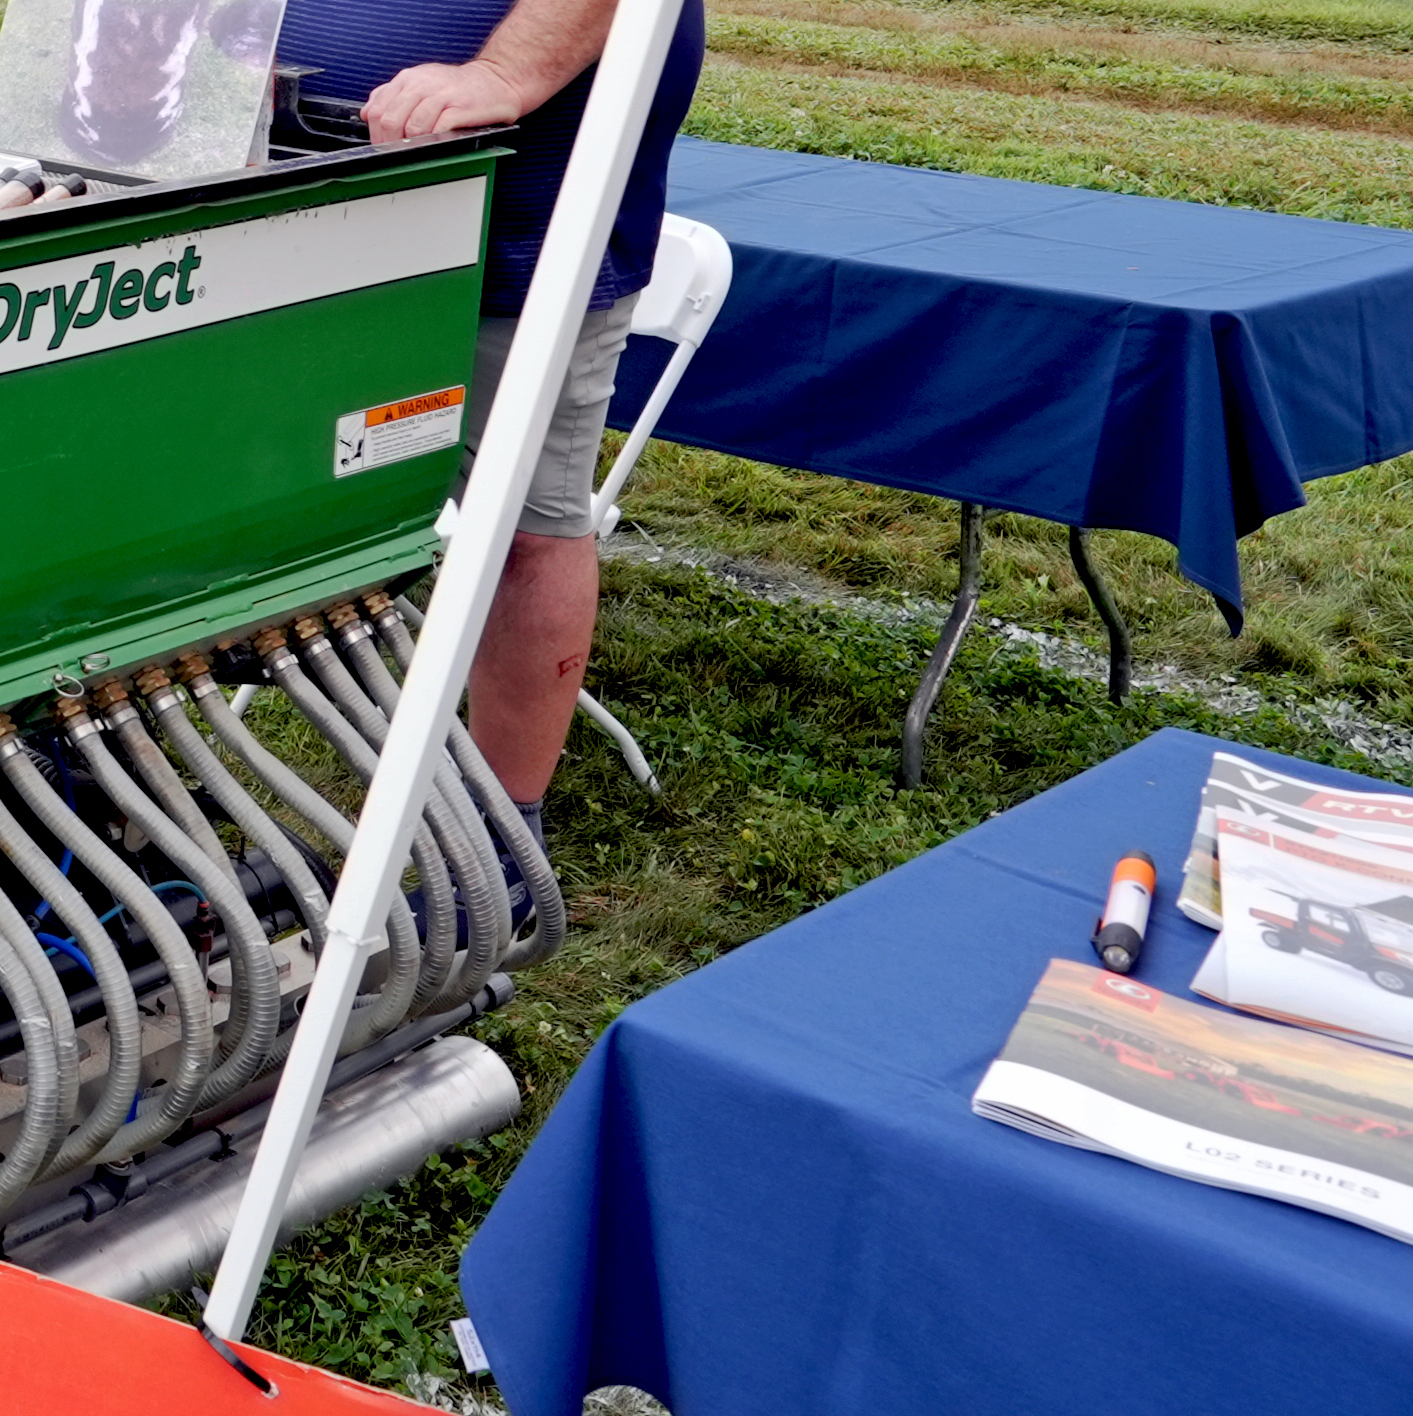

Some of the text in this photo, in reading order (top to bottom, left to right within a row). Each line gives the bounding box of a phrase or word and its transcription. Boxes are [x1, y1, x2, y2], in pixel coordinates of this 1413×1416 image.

[398, 393, 450, 416] WARNING
[434, 407, 457, 418] HAZARD
[1255, 1159, 1381, 1200] SERIES
